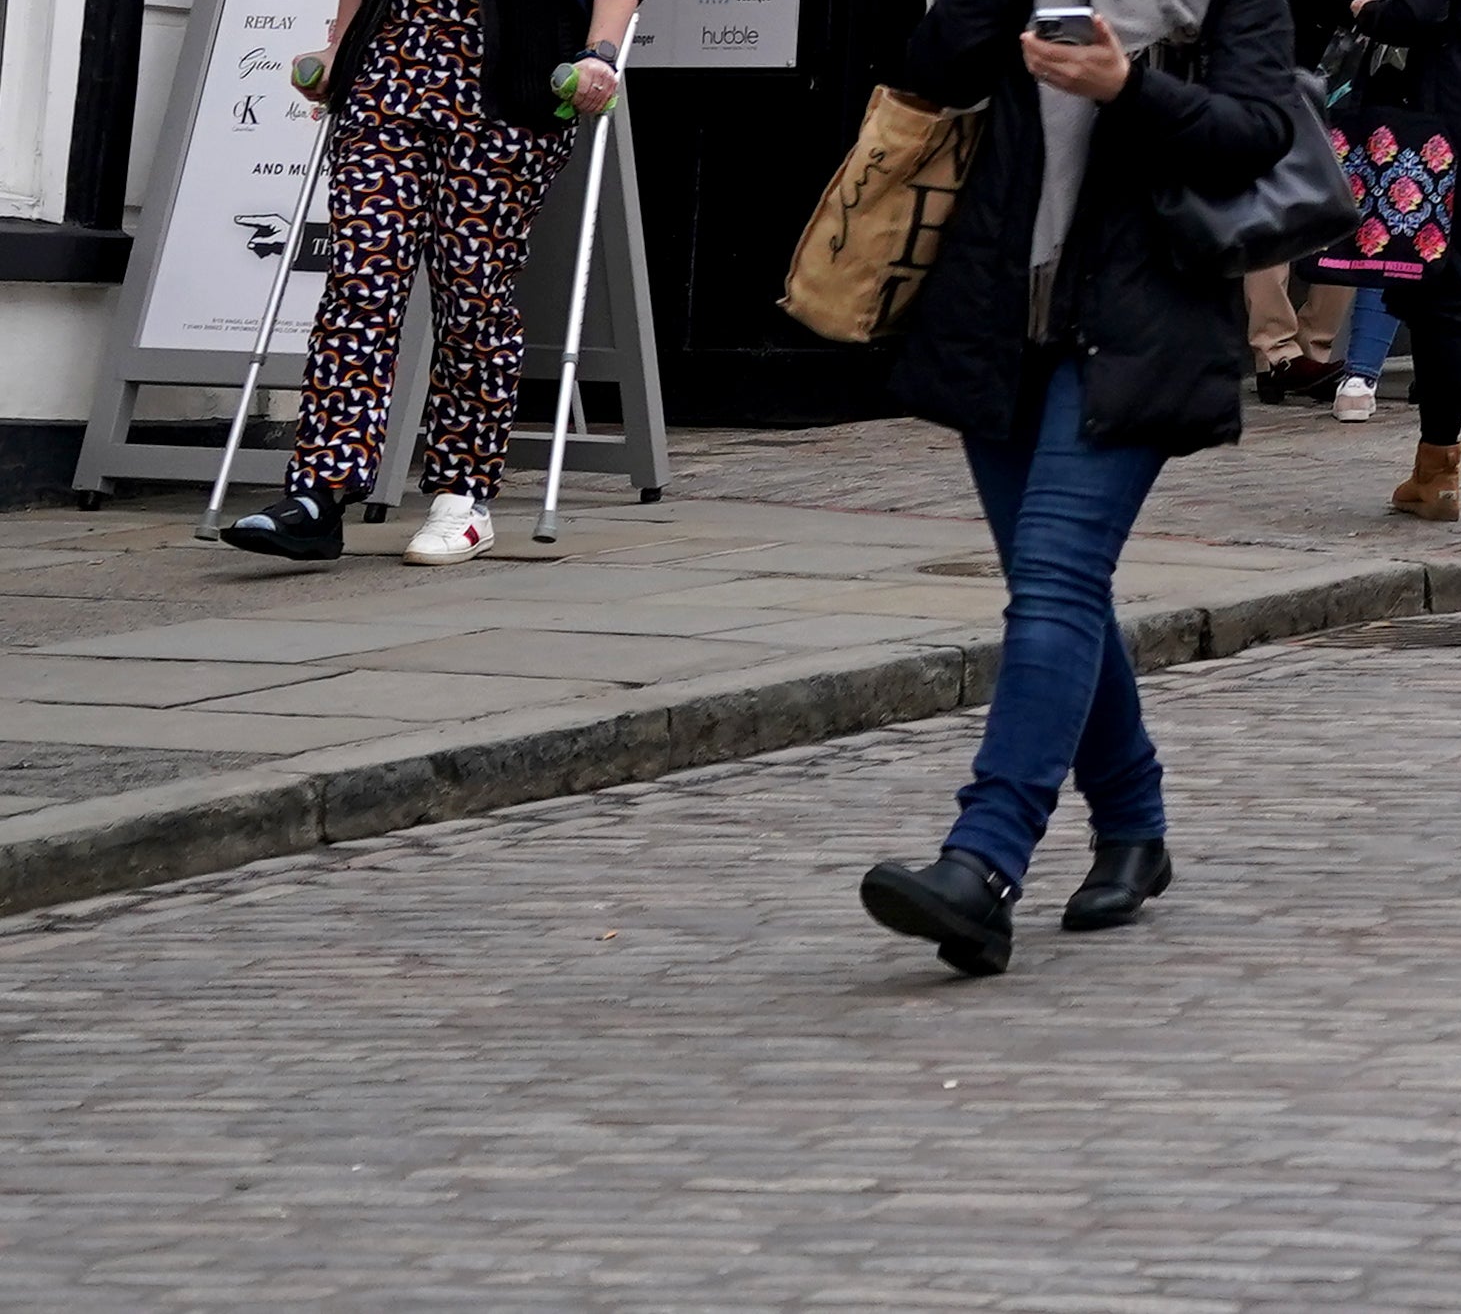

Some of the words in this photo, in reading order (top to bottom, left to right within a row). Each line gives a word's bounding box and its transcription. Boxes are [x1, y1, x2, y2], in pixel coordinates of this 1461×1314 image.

[244, 16, 296, 30] REPLAY
[702, 26, 759, 44] hubble
[238, 47, 282, 80] Gian
[253, 163, 283, 175] AND
